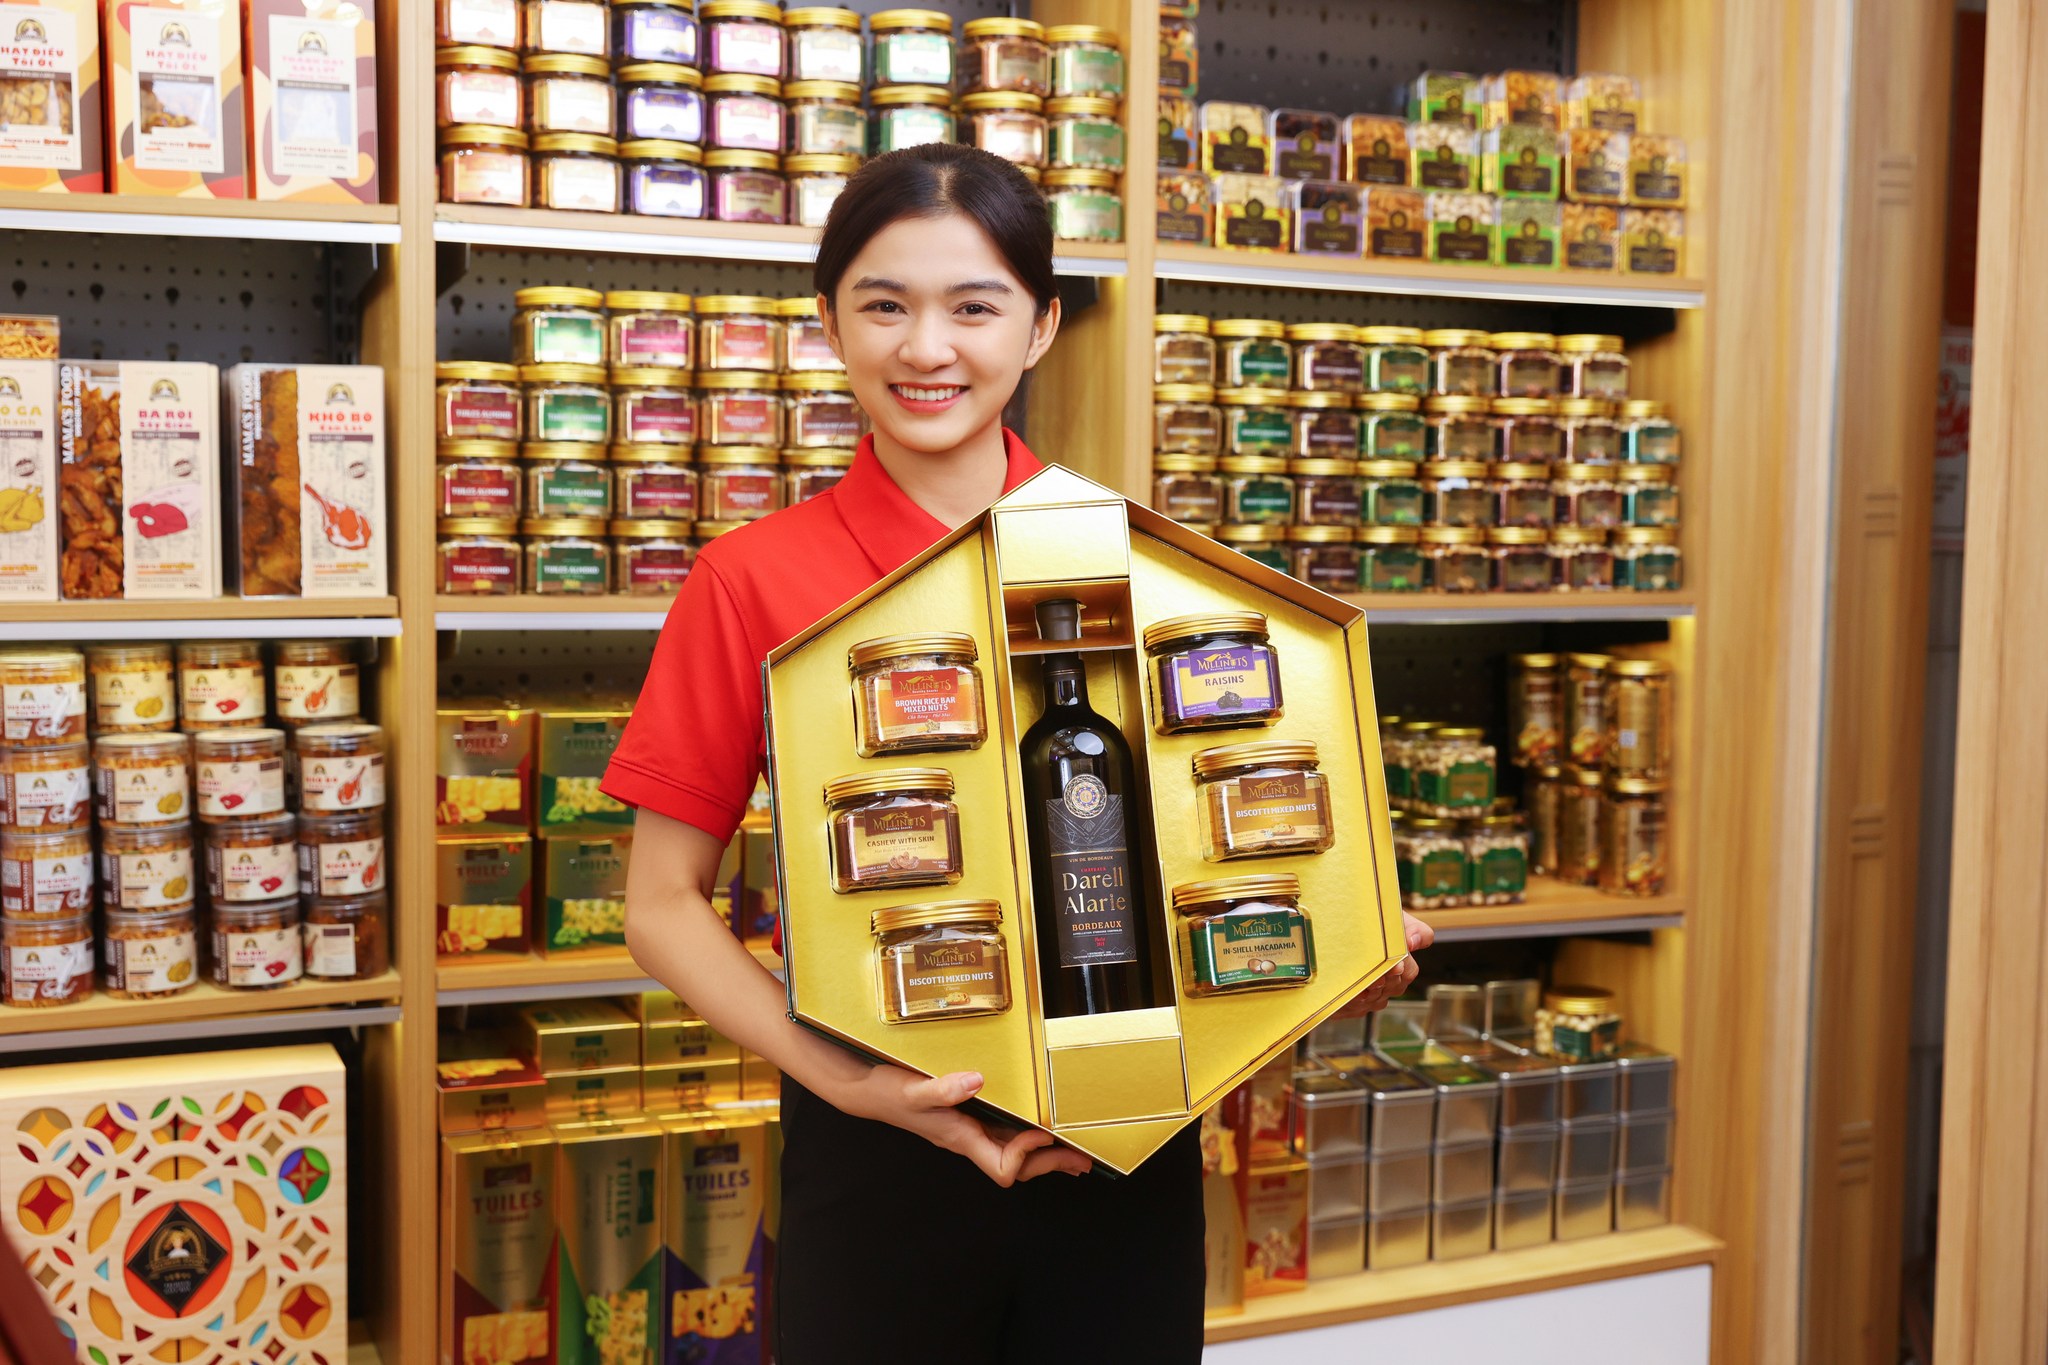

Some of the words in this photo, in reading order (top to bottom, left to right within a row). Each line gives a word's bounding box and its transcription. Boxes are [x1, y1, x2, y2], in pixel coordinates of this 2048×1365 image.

[1205, 675, 1244, 686] RAISINS
[896, 699, 922, 707] BROWN
[904, 704, 926, 713] MIXED
[1236, 808, 1270, 818] BISCOTTI
[1271, 806, 1294, 814] MIXED
[866, 838, 896, 847] CASHEW
[1062, 866, 1124, 891] Darell
[1064, 893, 1126, 914] Alarie
[1072, 920, 1122, 931] BORDEAUX
[1223, 945, 1252, 954] IN-SHELL
[1254, 942, 1296, 952] MACADAMIA
[910, 976, 944, 986] BISCOTTI
[946, 974, 970, 982] MIXED
[972, 972, 994, 980] NUTS
[684, 1168, 750, 1192] TUILES
[473, 1190, 543, 1215] TUILES
